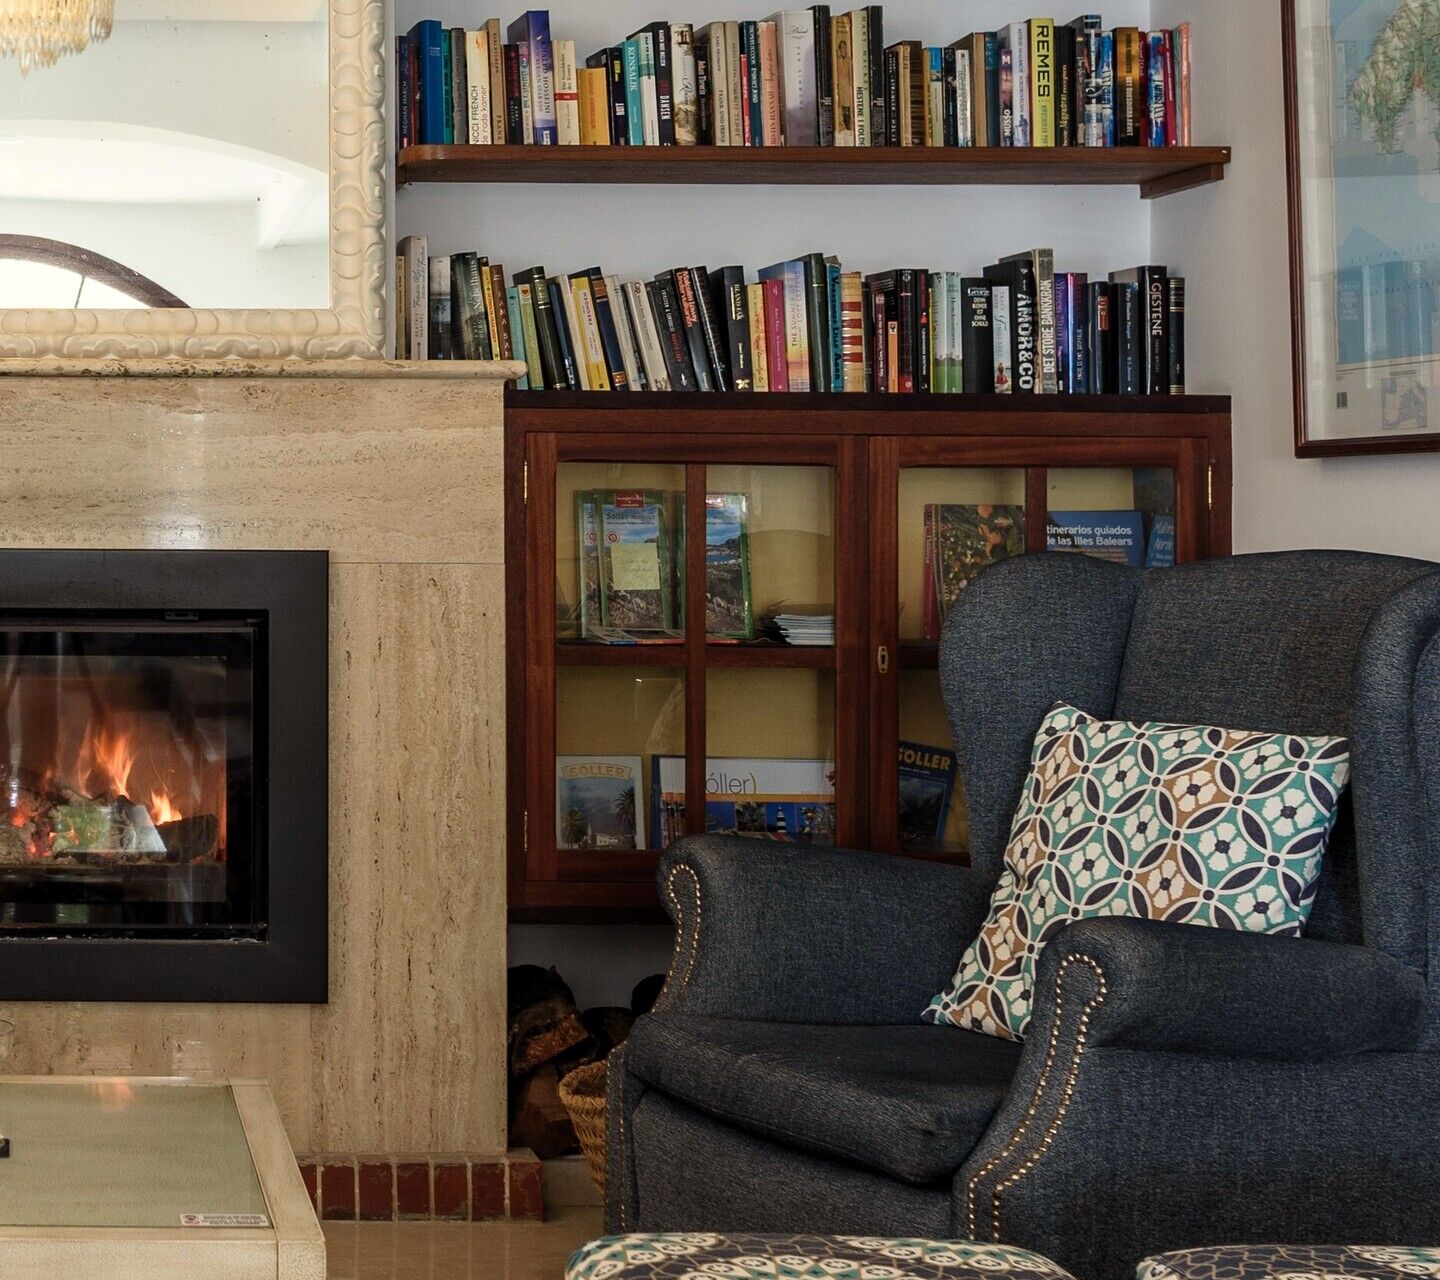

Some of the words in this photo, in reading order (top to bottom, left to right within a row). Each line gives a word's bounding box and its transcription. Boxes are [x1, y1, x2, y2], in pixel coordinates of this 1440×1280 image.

[627, 47, 637, 91] KONSALIK
[698, 60, 706, 75] Johan
[1036, 25, 1050, 97] REMES
[542, 76, 551, 113] HOSSEINI
[660, 95, 670, 120] DANSEN
[469, 260, 482, 310] Nebelhaus
[634, 282, 642, 294] Cap
[682, 271, 694, 301] Malcolm
[688, 302, 697, 322] Lowry
[1149, 282, 1162, 336] GJESTENE
[1017, 293, 1033, 390] AMOR&CO
[1043, 328, 1053, 355] STORE
[1043, 358, 1054, 373] DET
[1057, 537, 1072, 546] las
[1074, 536, 1094, 546] Illes
[1096, 536, 1132, 546] Balears
[1094, 525, 1132, 537] guiados
